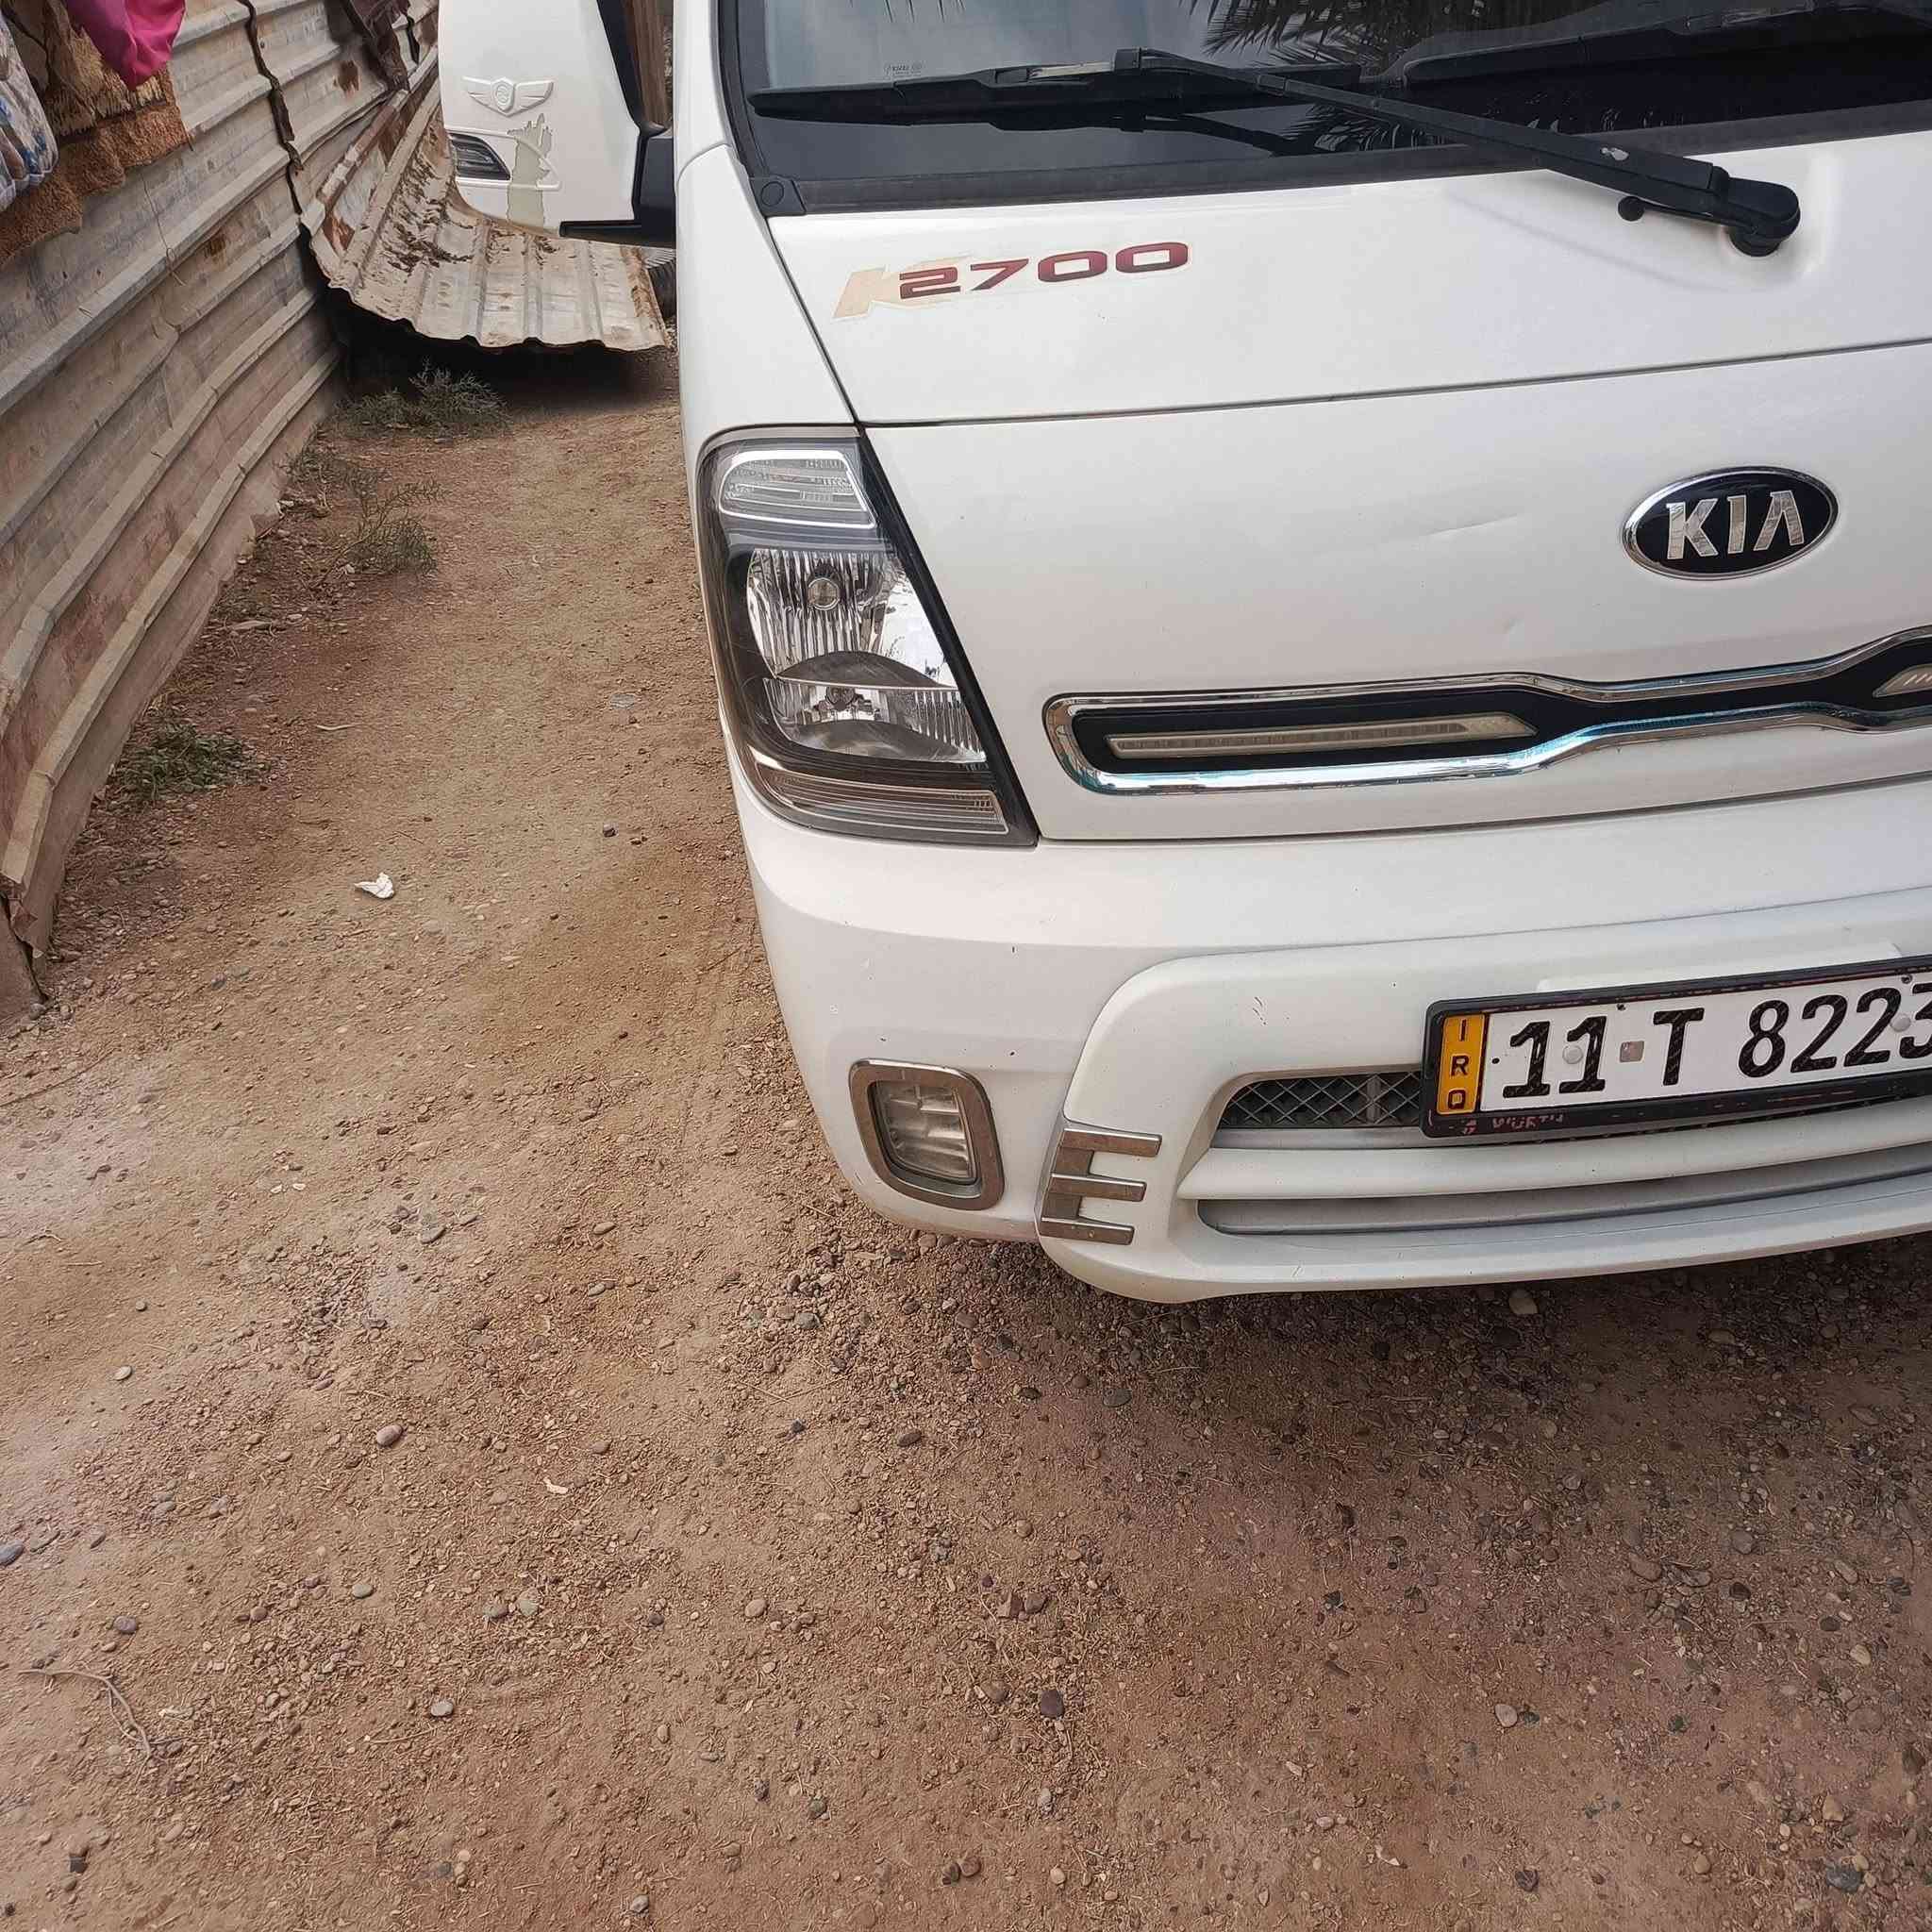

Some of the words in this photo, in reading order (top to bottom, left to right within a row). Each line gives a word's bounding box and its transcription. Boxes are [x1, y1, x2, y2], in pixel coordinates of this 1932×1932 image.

[1665, 490, 1806, 560] KIA
[1503, 1015, 1607, 1098] 11
[1653, 1008, 1705, 1086] T
[1738, 982, 1932, 1077] 8223
